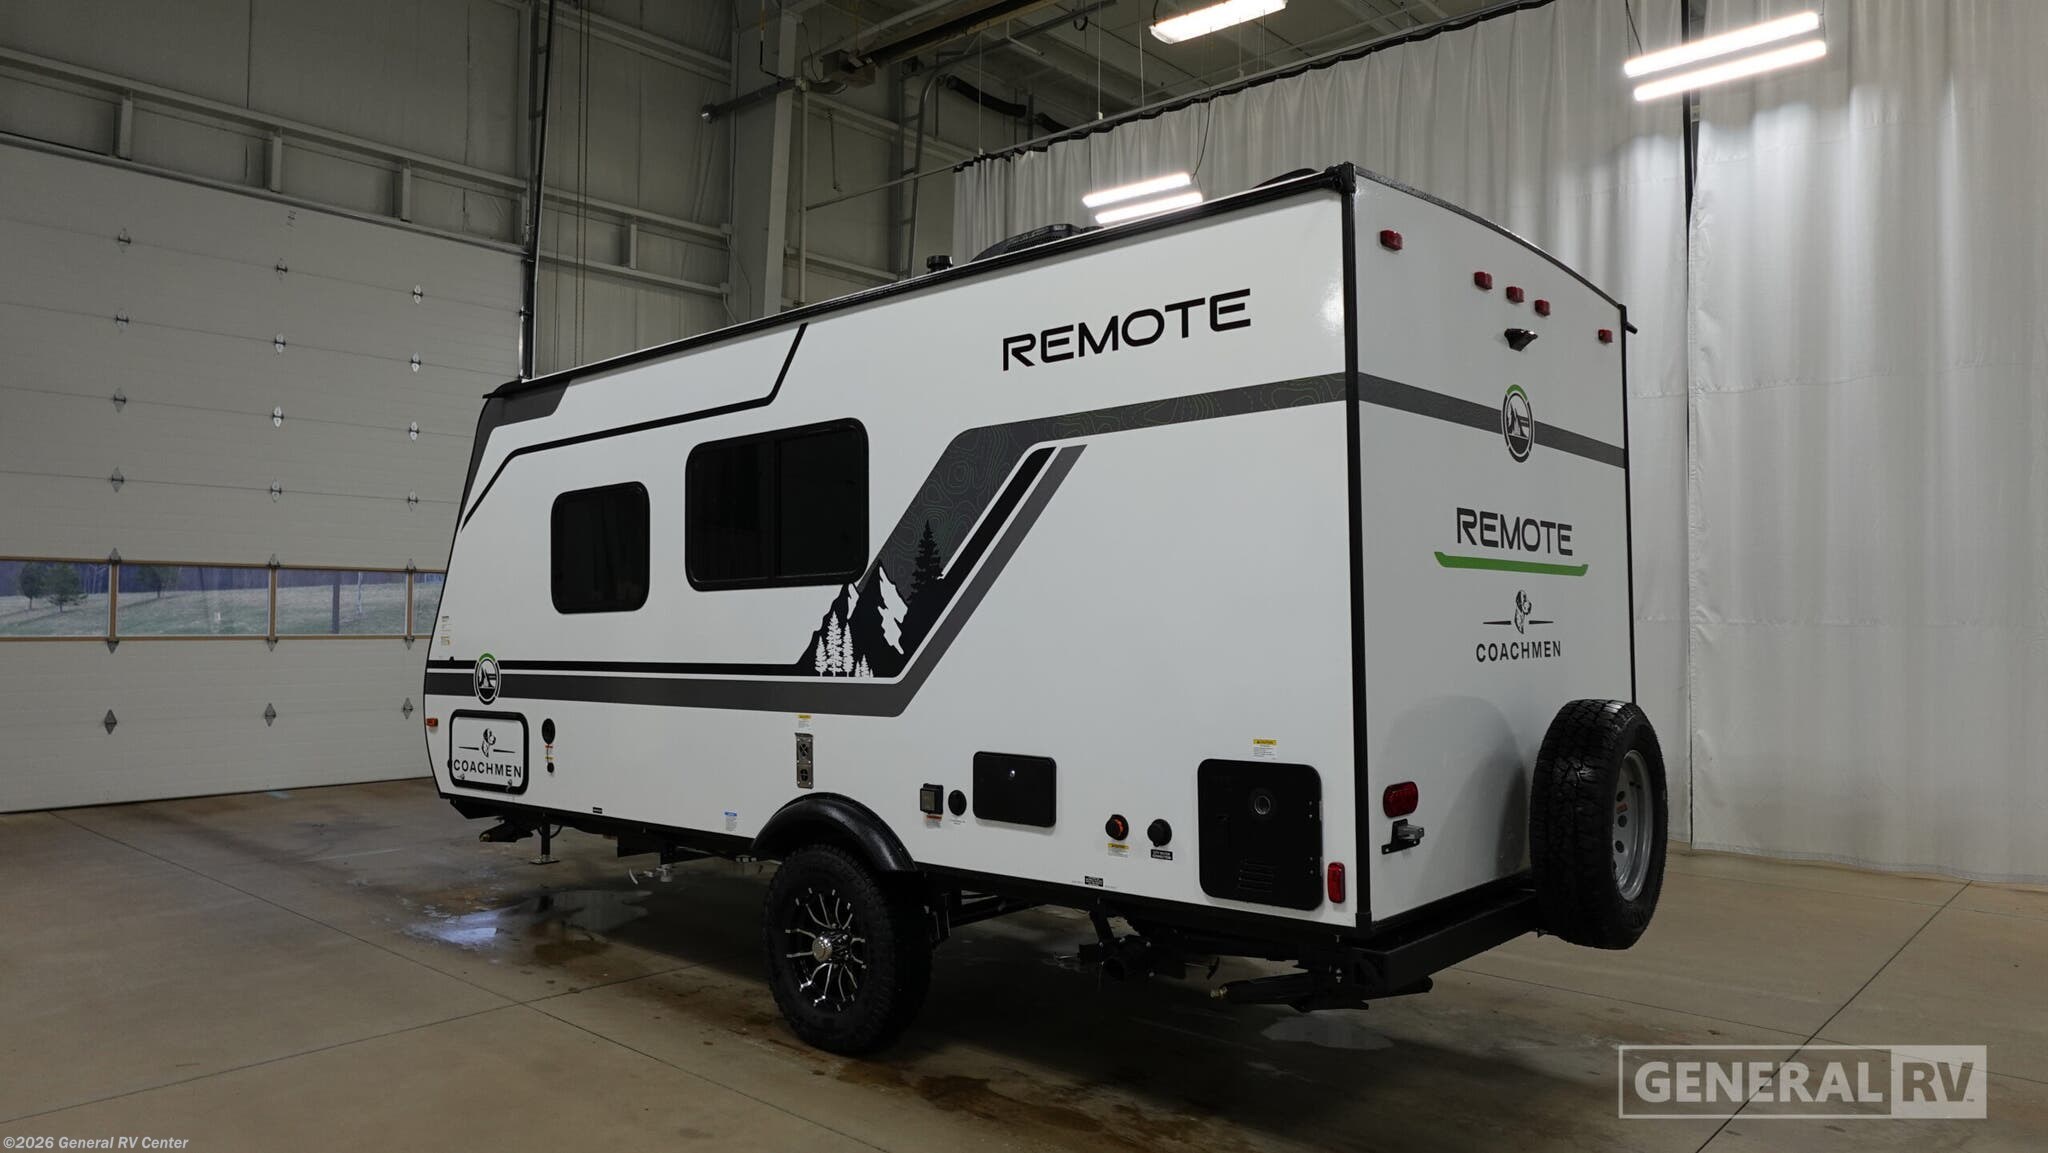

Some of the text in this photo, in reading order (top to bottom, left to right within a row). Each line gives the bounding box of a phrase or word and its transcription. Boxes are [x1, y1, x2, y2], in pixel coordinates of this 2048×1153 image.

[1002, 288, 1251, 371] REMOTE
[1456, 507, 1573, 556] REMOTE
[1476, 641, 1561, 662] COACHMEN
[453, 759, 522, 778] COACHMEN
